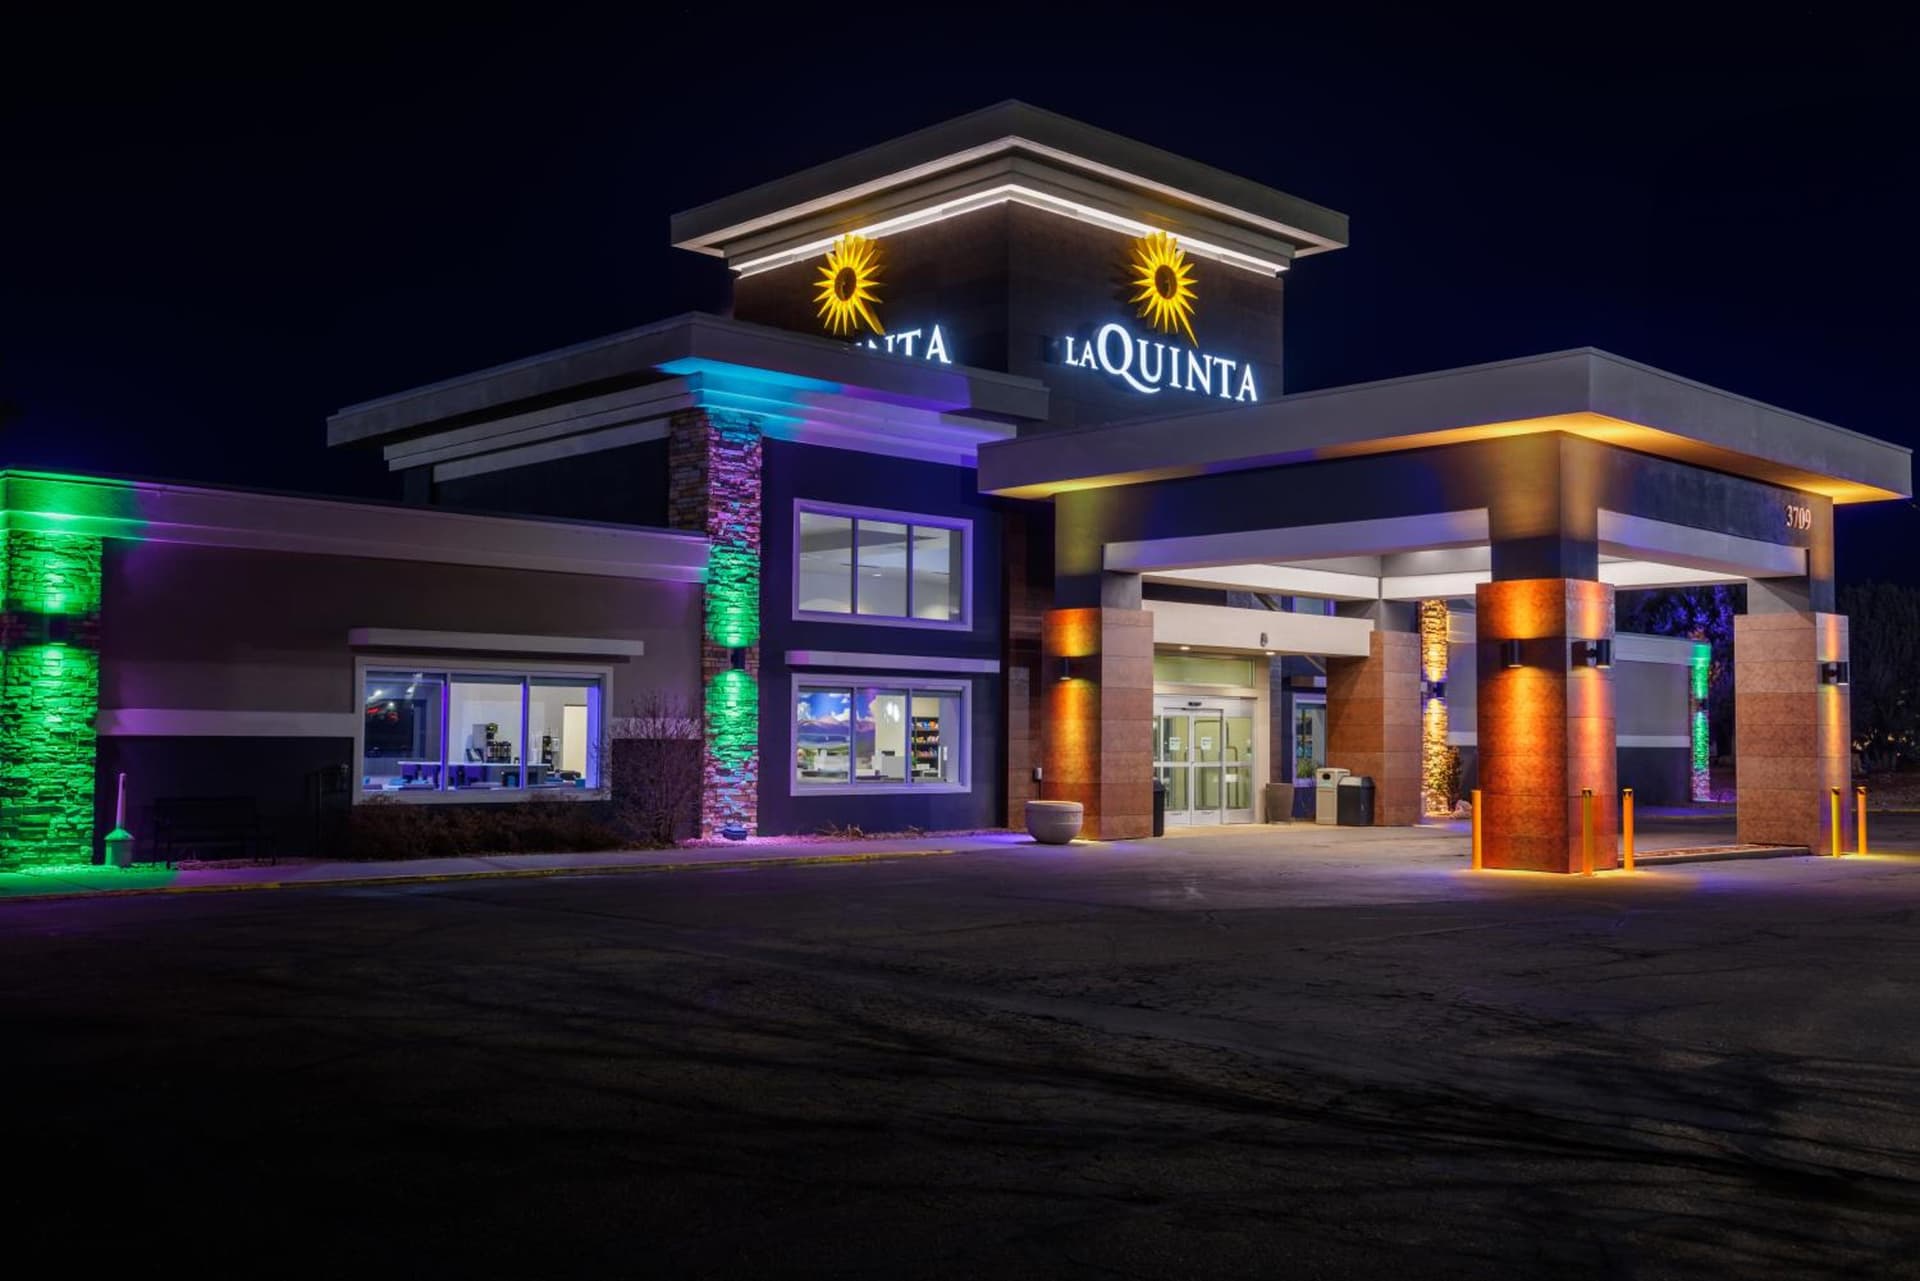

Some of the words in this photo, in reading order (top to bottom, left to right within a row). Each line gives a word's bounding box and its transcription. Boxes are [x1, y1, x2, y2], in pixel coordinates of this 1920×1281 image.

[1065, 336, 1098, 370] LA
[1097, 323, 1258, 402] QUINTA
[1785, 505, 1811, 530] 3709
